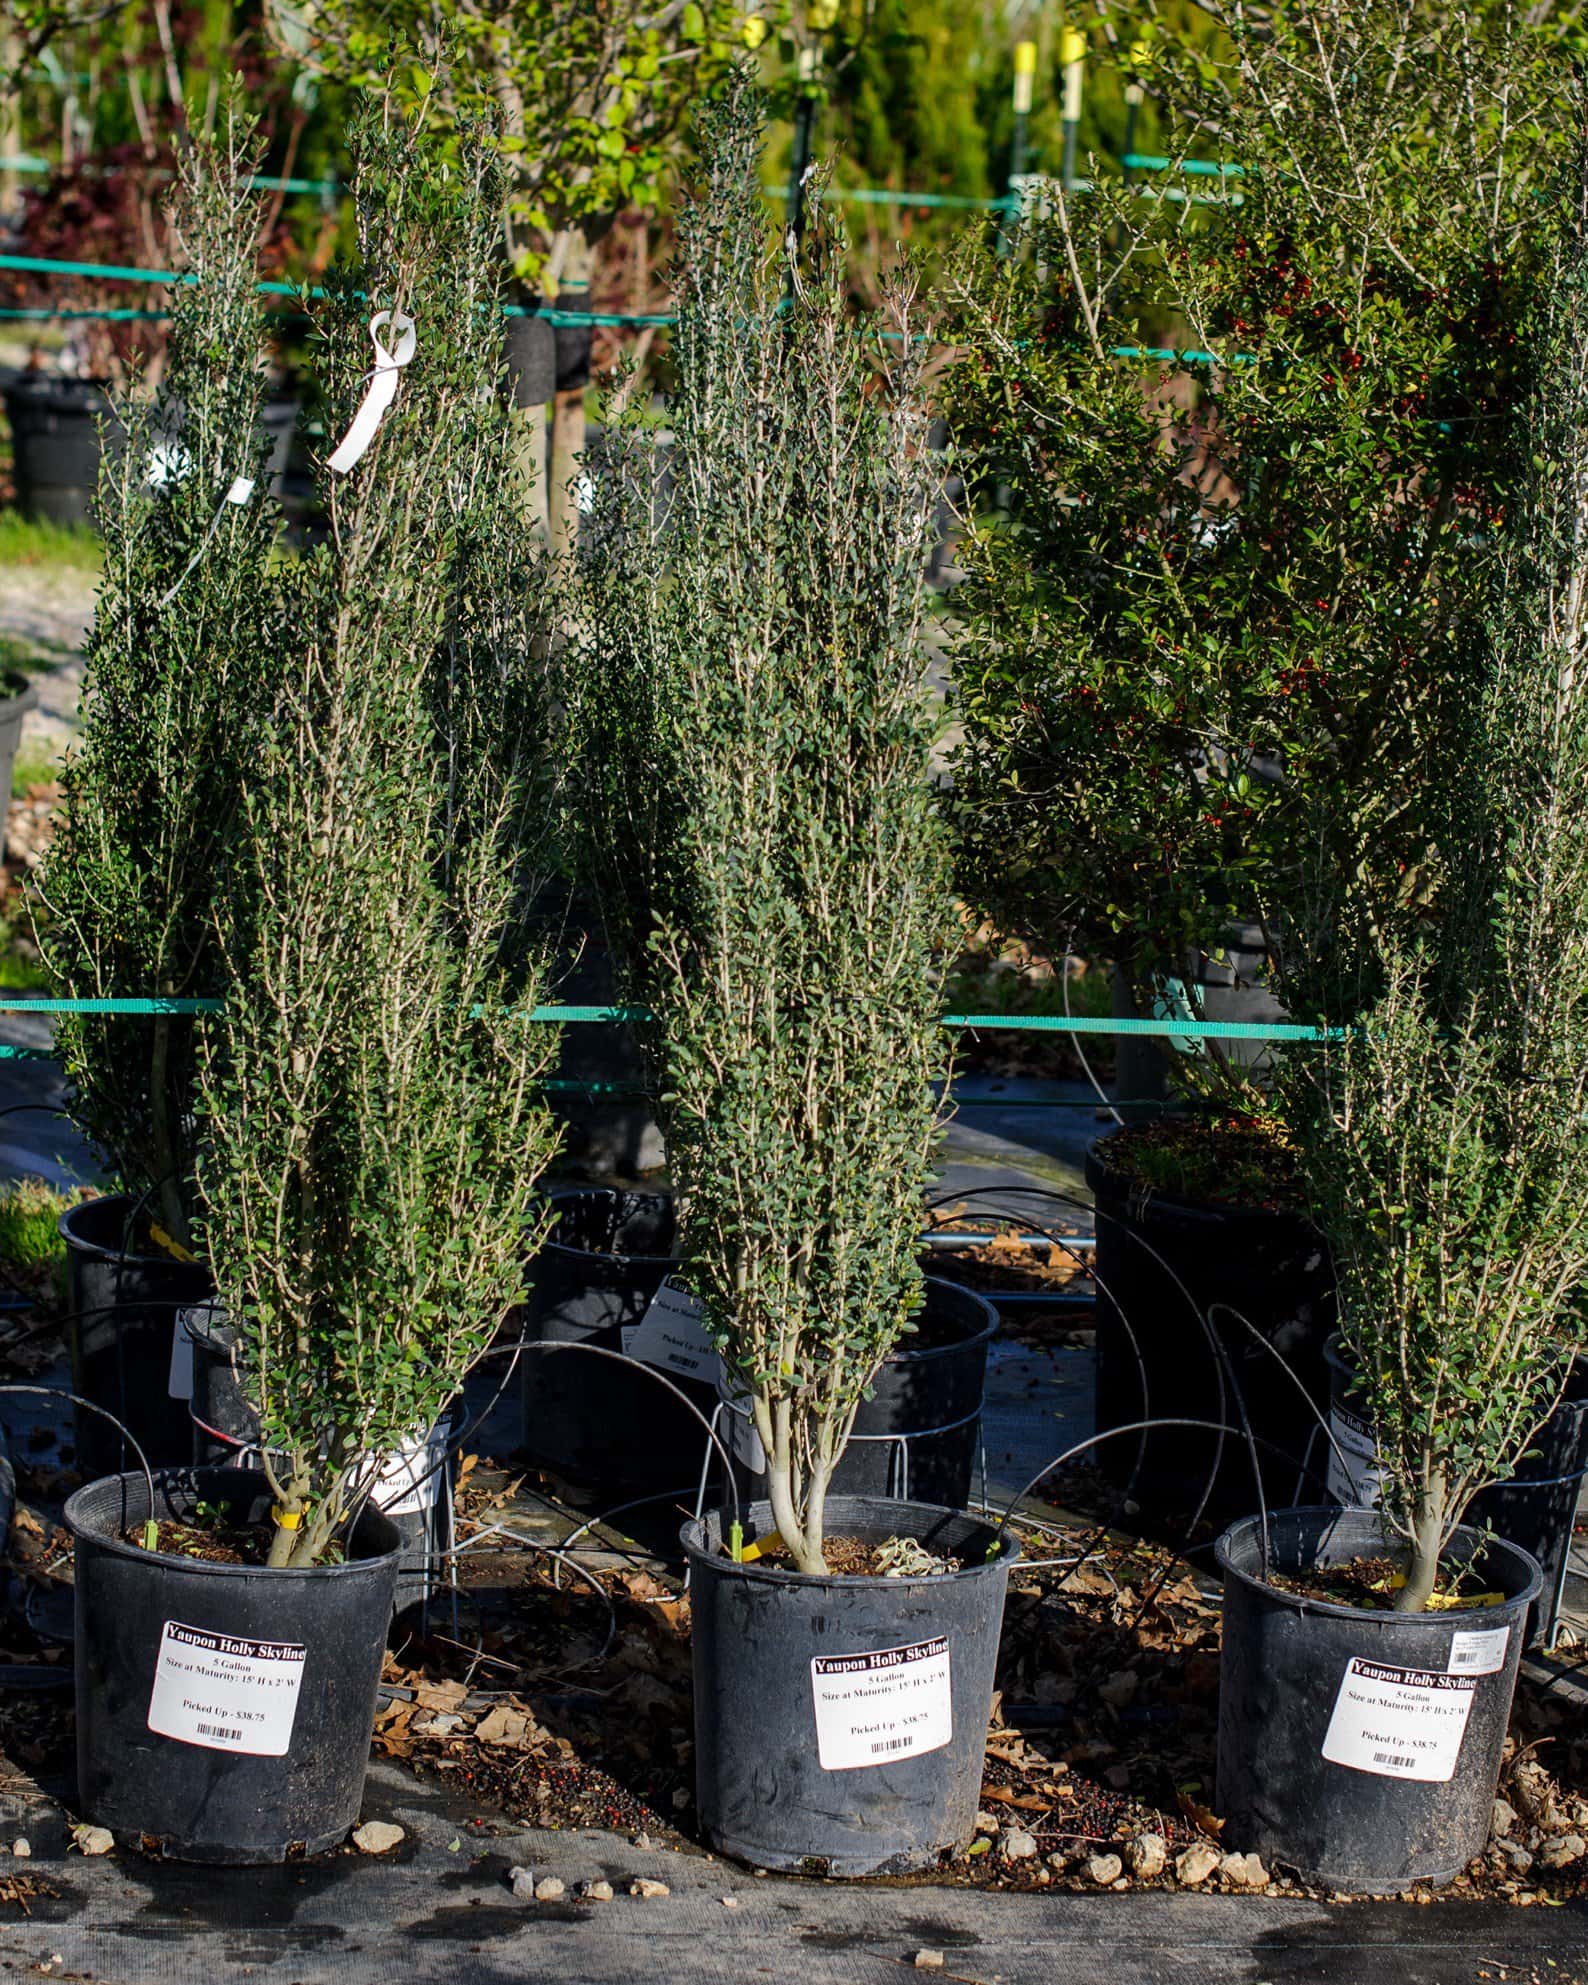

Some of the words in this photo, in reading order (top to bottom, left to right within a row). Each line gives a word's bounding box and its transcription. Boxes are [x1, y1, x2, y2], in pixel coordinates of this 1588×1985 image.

[168, 1625, 216, 1649] Yaupon
[220, 1639, 255, 1657] Holly
[258, 1646, 304, 1661] Skyline
[213, 1658, 218, 1666] 5
[221, 1660, 251, 1672] Gallon
[816, 1660, 866, 1673] Yaupon
[870, 1653, 903, 1667] Holly
[907, 1642, 948, 1660] Skyline
[166, 1657, 182, 1668] Size
[196, 1665, 239, 1682] Maturity:
[257, 1677, 265, 1685] H
[287, 1679, 296, 1687] W
[876, 1673, 905, 1683] Gallon
[1354, 1661, 1401, 1683] Yaupon
[1404, 1672, 1435, 1687] Holly
[1438, 1676, 1476, 1690] Skyline
[822, 1692, 840, 1700] Size
[842, 1690, 851, 1699] at
[854, 1686, 895, 1698] Maturity:
[1347, 1690, 1364, 1702] Size
[1367, 1696, 1376, 1704] at
[1378, 1697, 1419, 1713] Maturity:
[1404, 1692, 1430, 1702] Gallon
[183, 1700, 212, 1714] Picked
[215, 1708, 227, 1718] Up
[236, 1711, 265, 1722] $38.75
[851, 1723, 880, 1735] Picked
[883, 1722, 895, 1731] Up
[1362, 1730, 1390, 1744] Picked
[1393, 1736, 1404, 1747] Up
